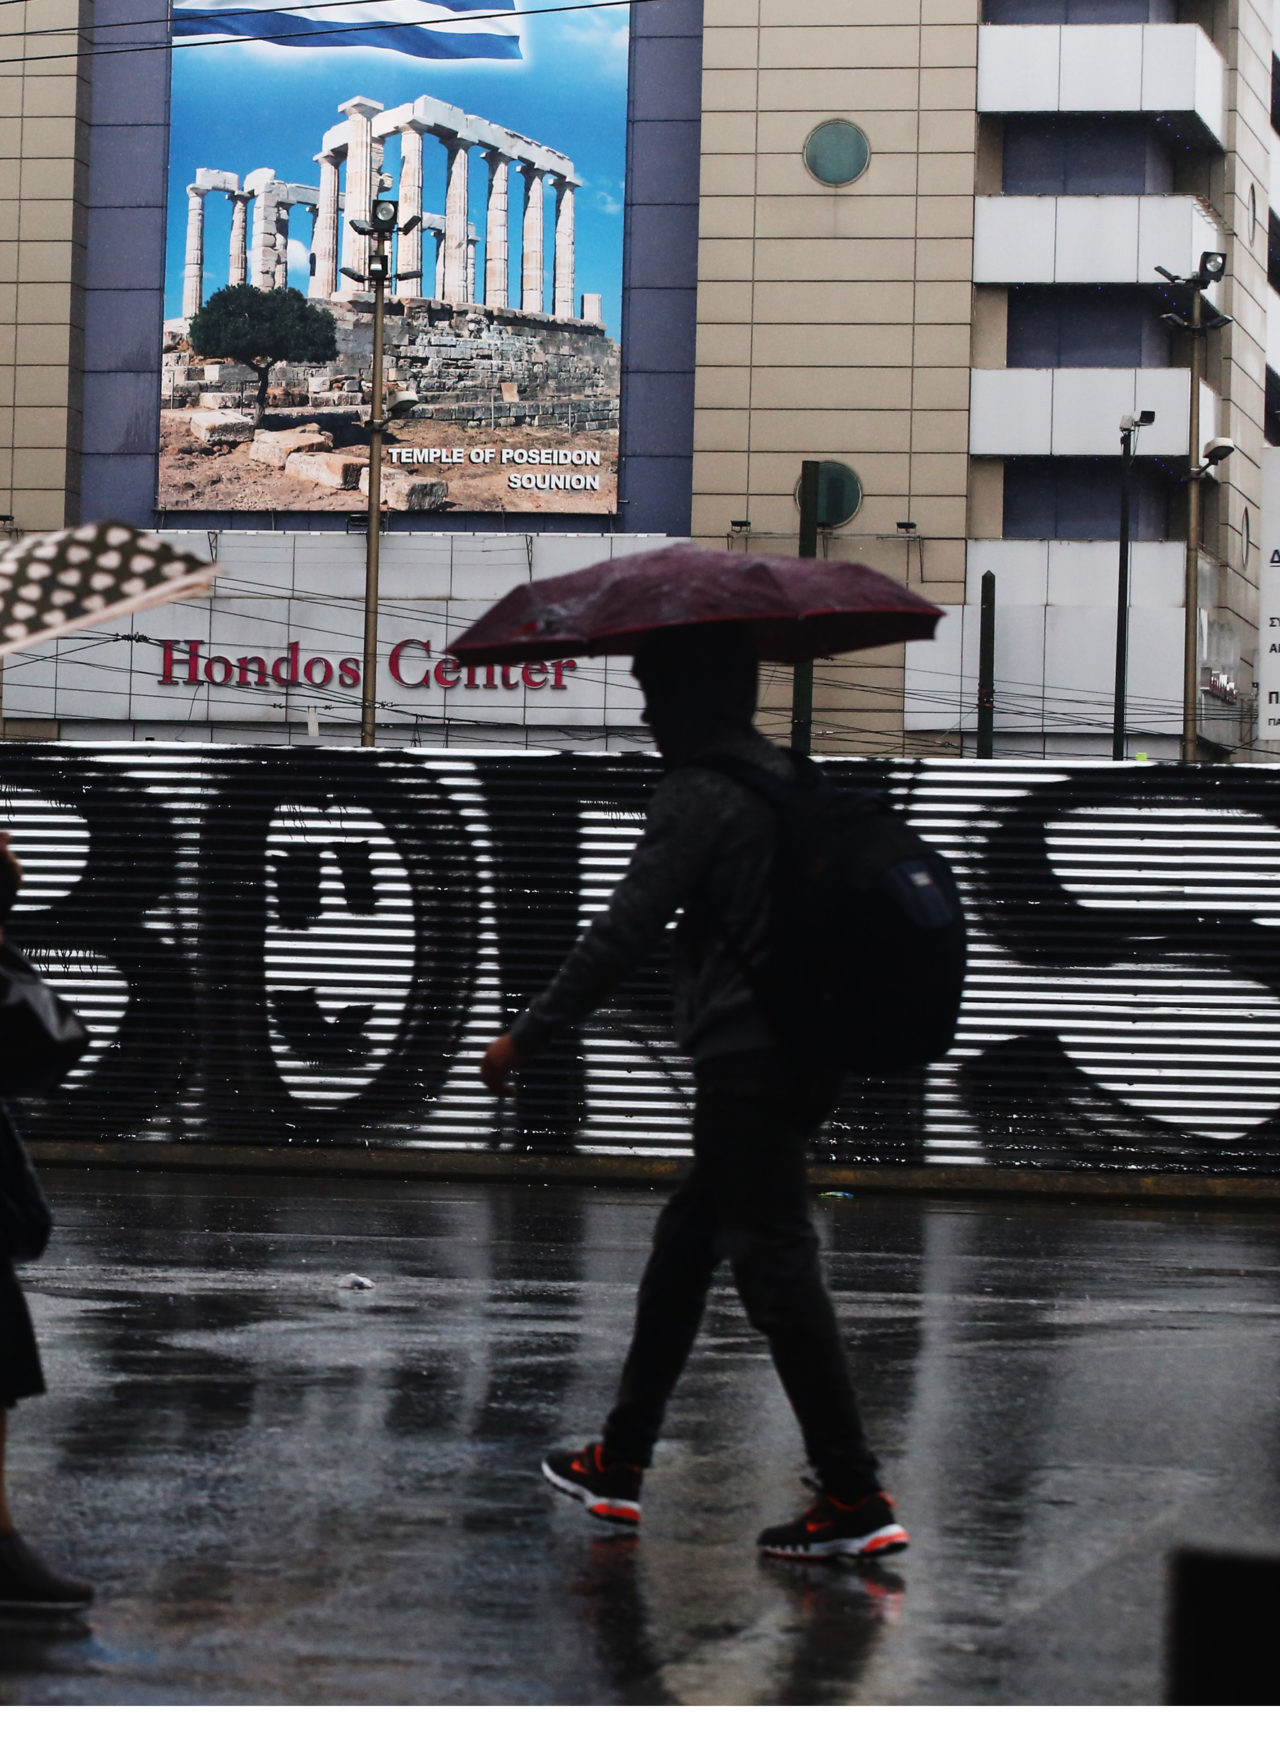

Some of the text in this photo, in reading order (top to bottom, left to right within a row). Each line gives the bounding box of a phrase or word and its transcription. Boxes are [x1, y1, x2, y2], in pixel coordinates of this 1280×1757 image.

[388, 448, 601, 466] TEMPLE OF POSEIDON
[508, 473, 600, 491] SOUNION
[157, 639, 361, 688] Hondos
